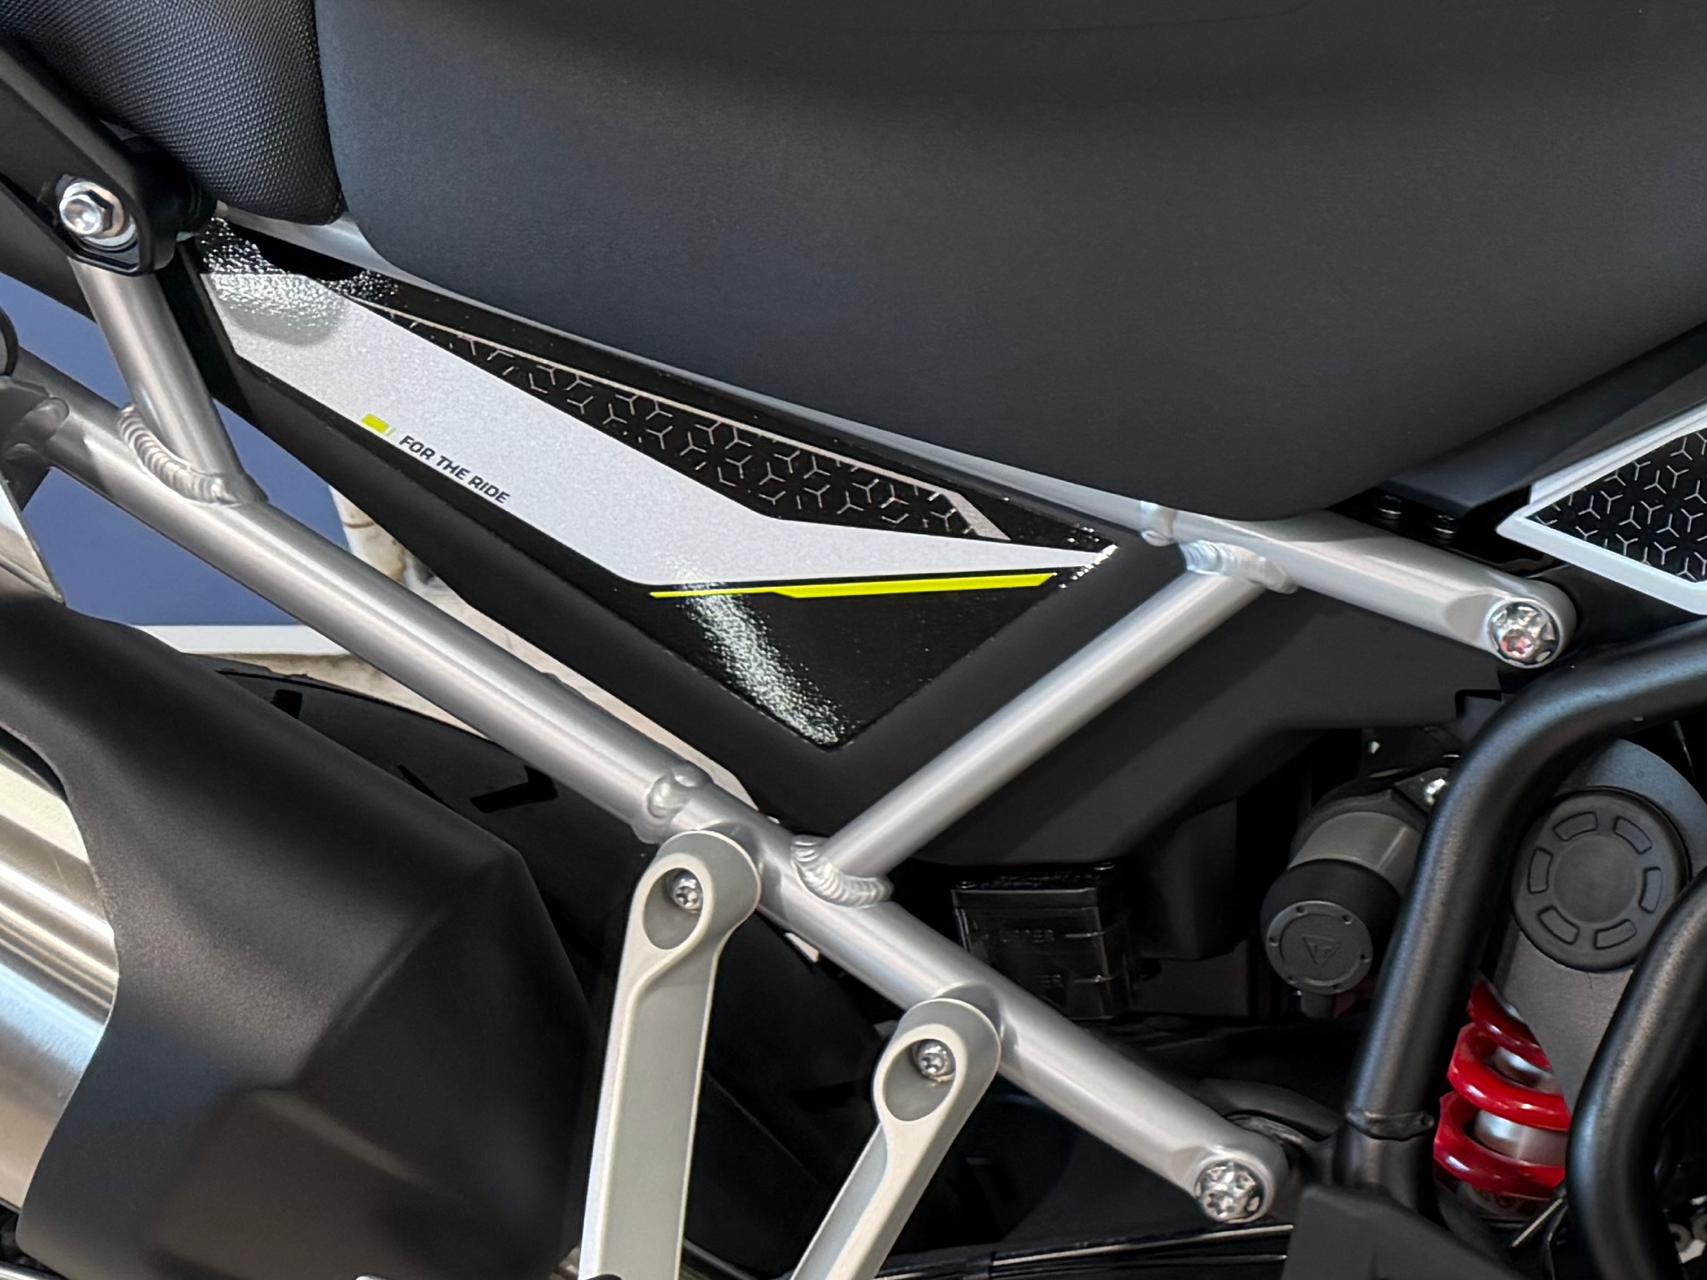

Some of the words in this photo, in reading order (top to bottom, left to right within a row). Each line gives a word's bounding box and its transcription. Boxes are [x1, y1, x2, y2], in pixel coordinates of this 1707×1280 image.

[399, 434, 435, 460] FOR
[436, 455, 470, 480] THE
[468, 475, 510, 503] RIDE
